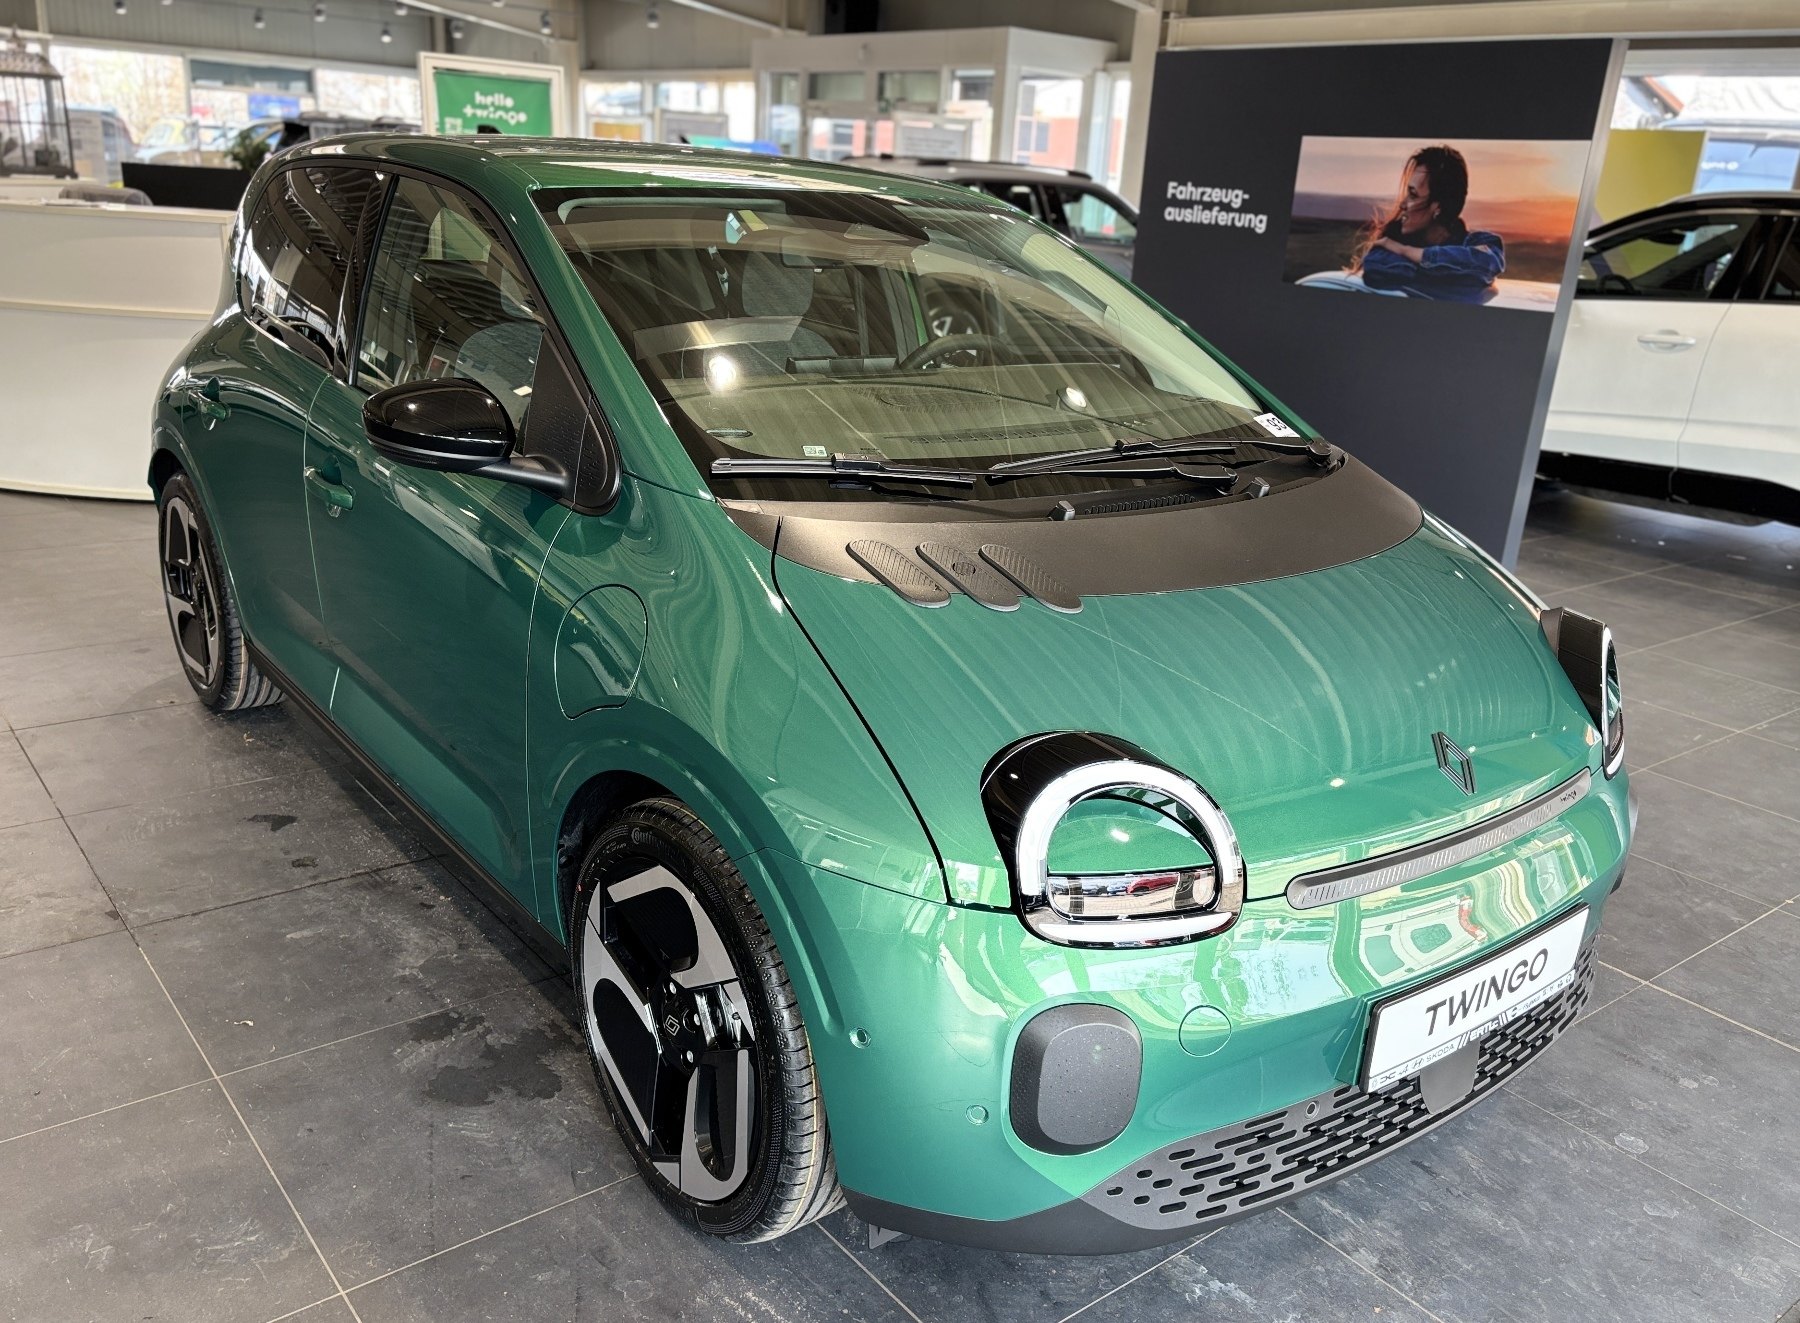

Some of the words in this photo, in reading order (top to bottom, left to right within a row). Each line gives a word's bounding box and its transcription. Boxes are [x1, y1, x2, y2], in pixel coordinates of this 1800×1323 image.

[474, 91, 514, 108] hello
[1166, 181, 1250, 209] Fahrzeug-
[1164, 204, 1268, 234] auslieferung
[1425, 948, 1548, 1036] TWINGO
